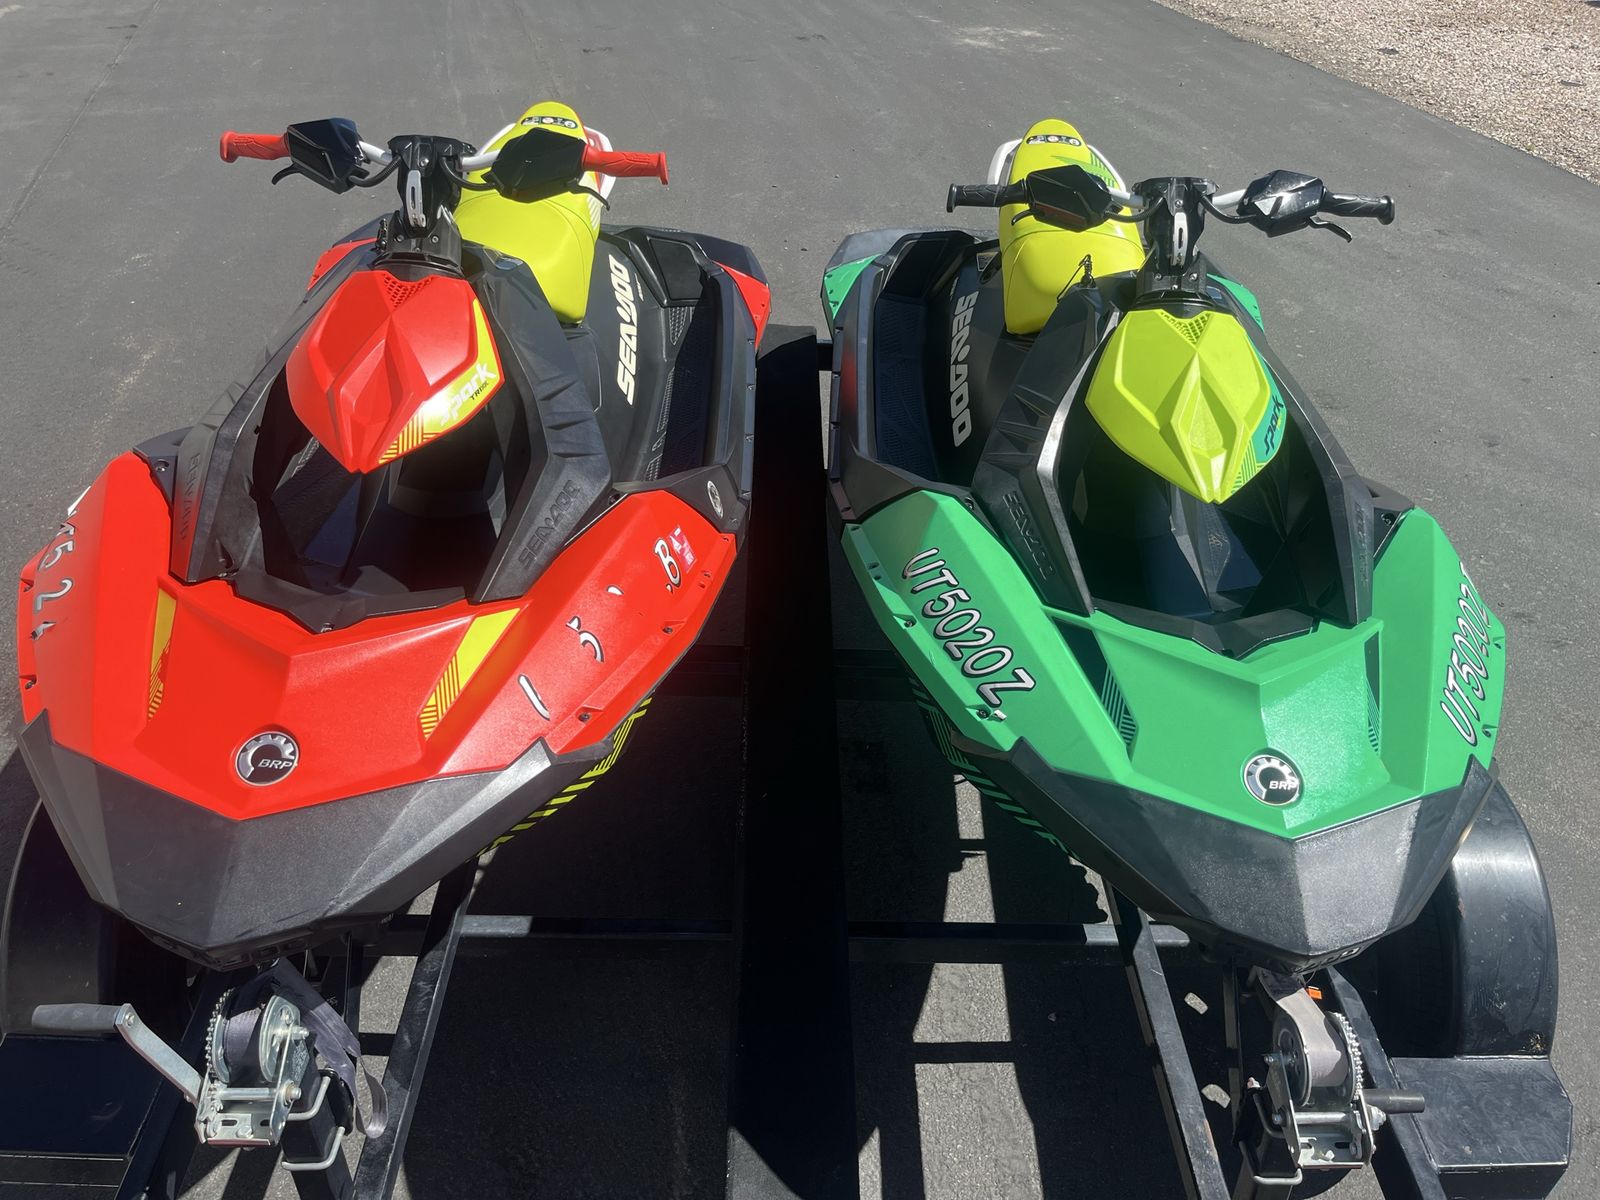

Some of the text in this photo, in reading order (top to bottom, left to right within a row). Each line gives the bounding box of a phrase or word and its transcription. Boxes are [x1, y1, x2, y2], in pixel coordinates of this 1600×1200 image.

[902, 547, 1037, 708] UT5020Z
[257, 758, 293, 770] BRP
[1269, 779, 1298, 790] BRP
